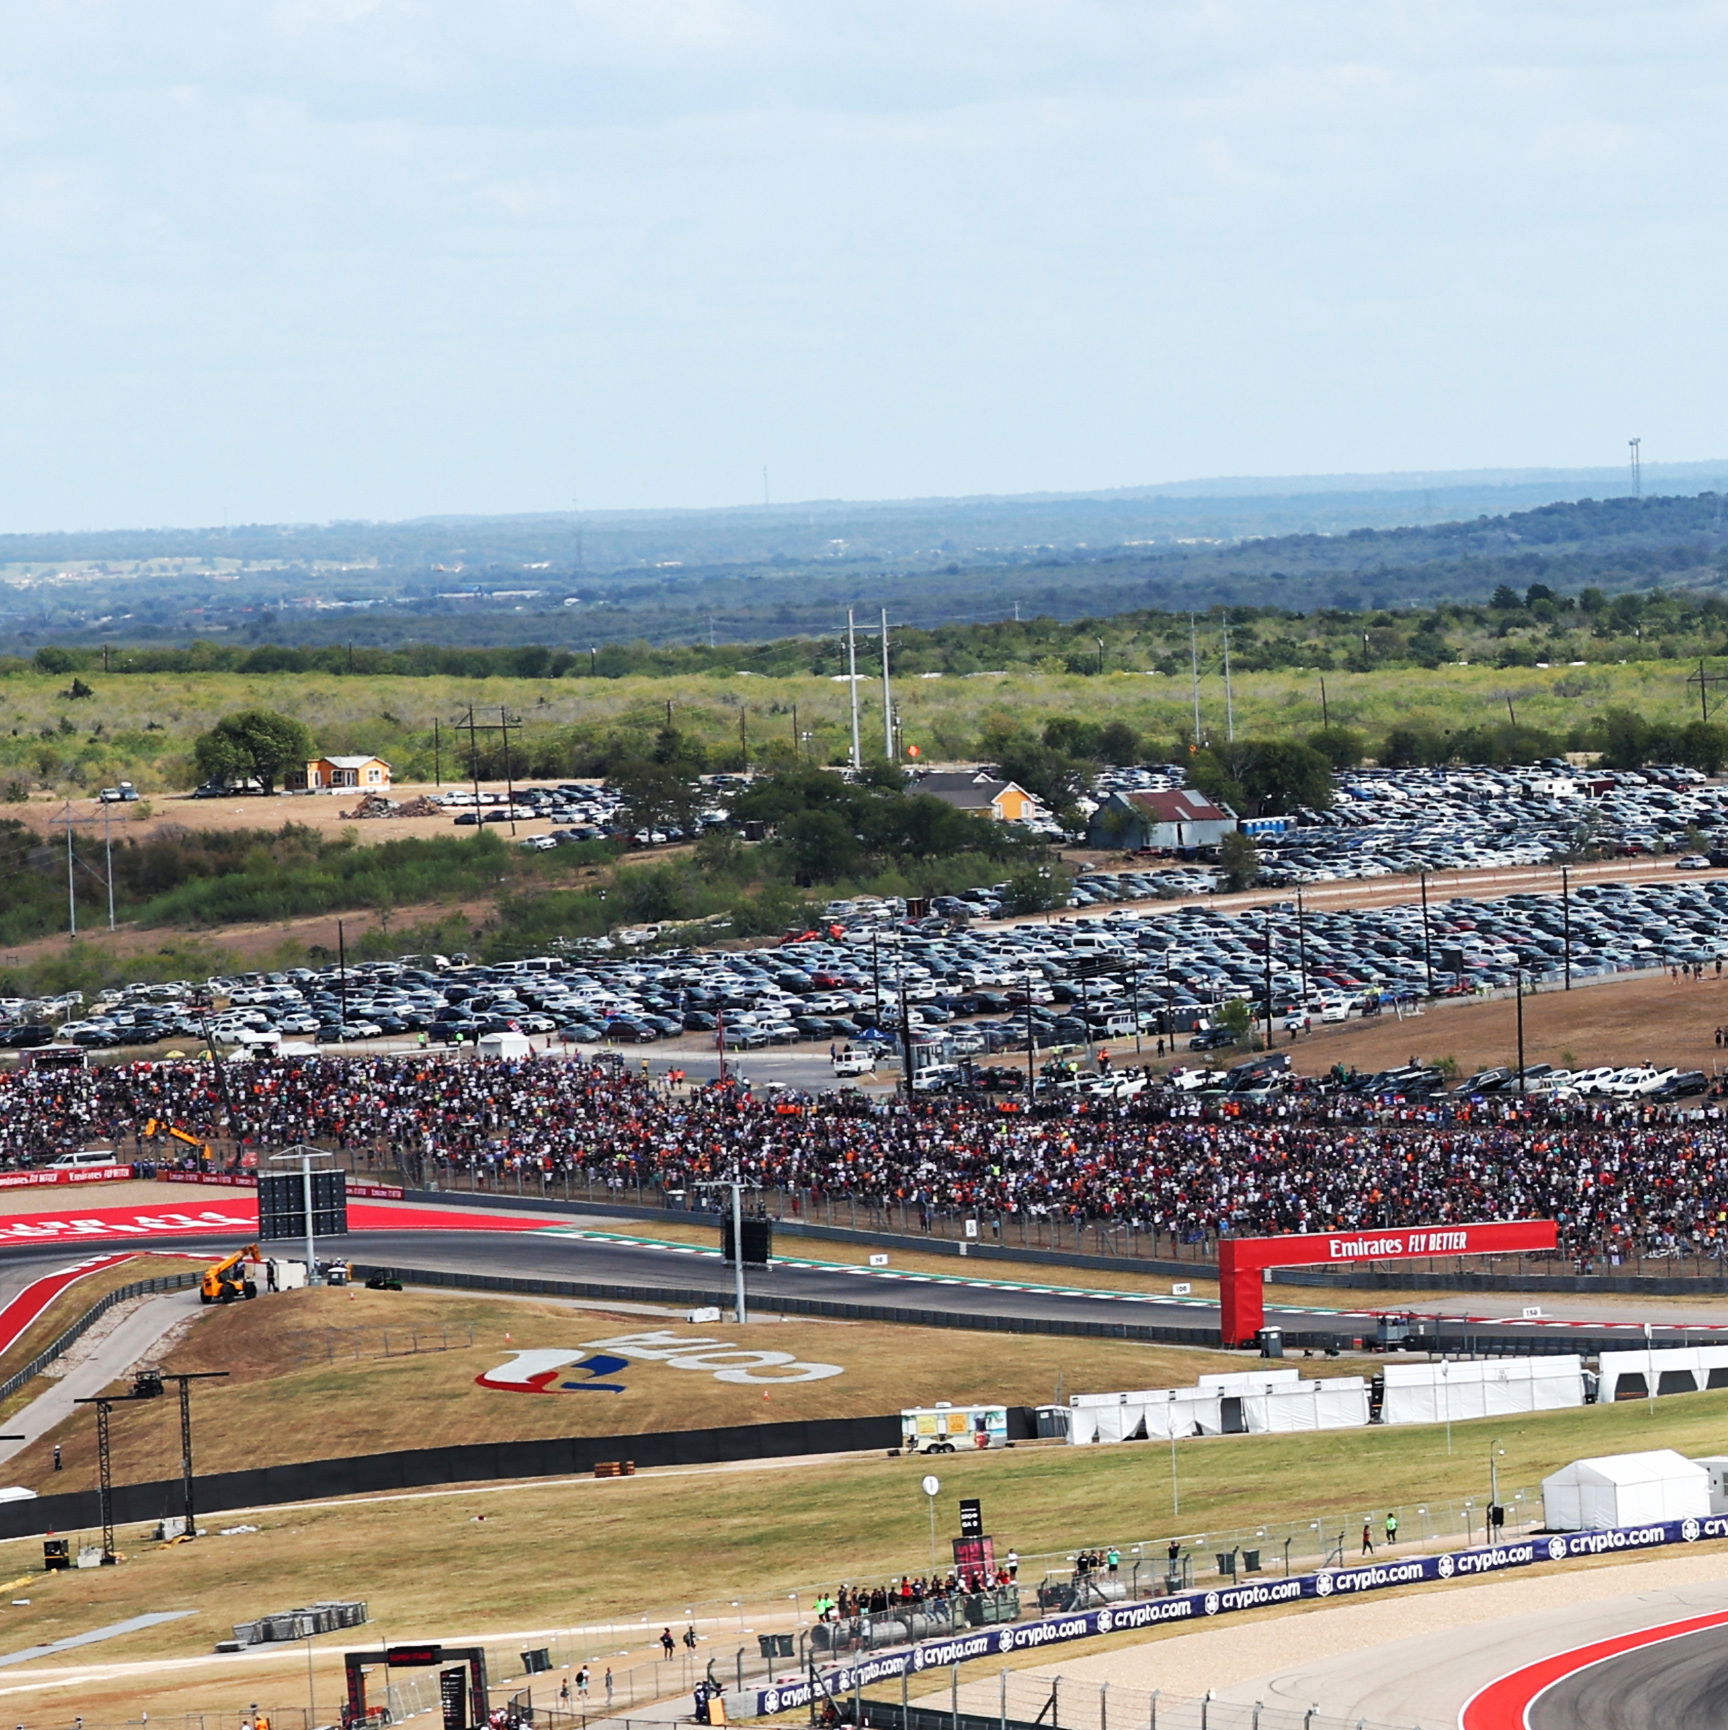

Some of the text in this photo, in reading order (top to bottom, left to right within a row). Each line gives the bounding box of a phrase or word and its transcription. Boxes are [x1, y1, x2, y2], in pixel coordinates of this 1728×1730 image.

[1330, 1231, 1467, 1258] Emirates FLY BETTER
[1570, 1525, 1664, 1554] crypto.com
[1336, 1562, 1423, 1591] crypto.com
[1221, 1581, 1300, 1609] crypto.com
[1114, 1600, 1191, 1628] crypto.com
[1015, 1617, 1087, 1646] crypto.com
[924, 1637, 988, 1666] crypto.com
